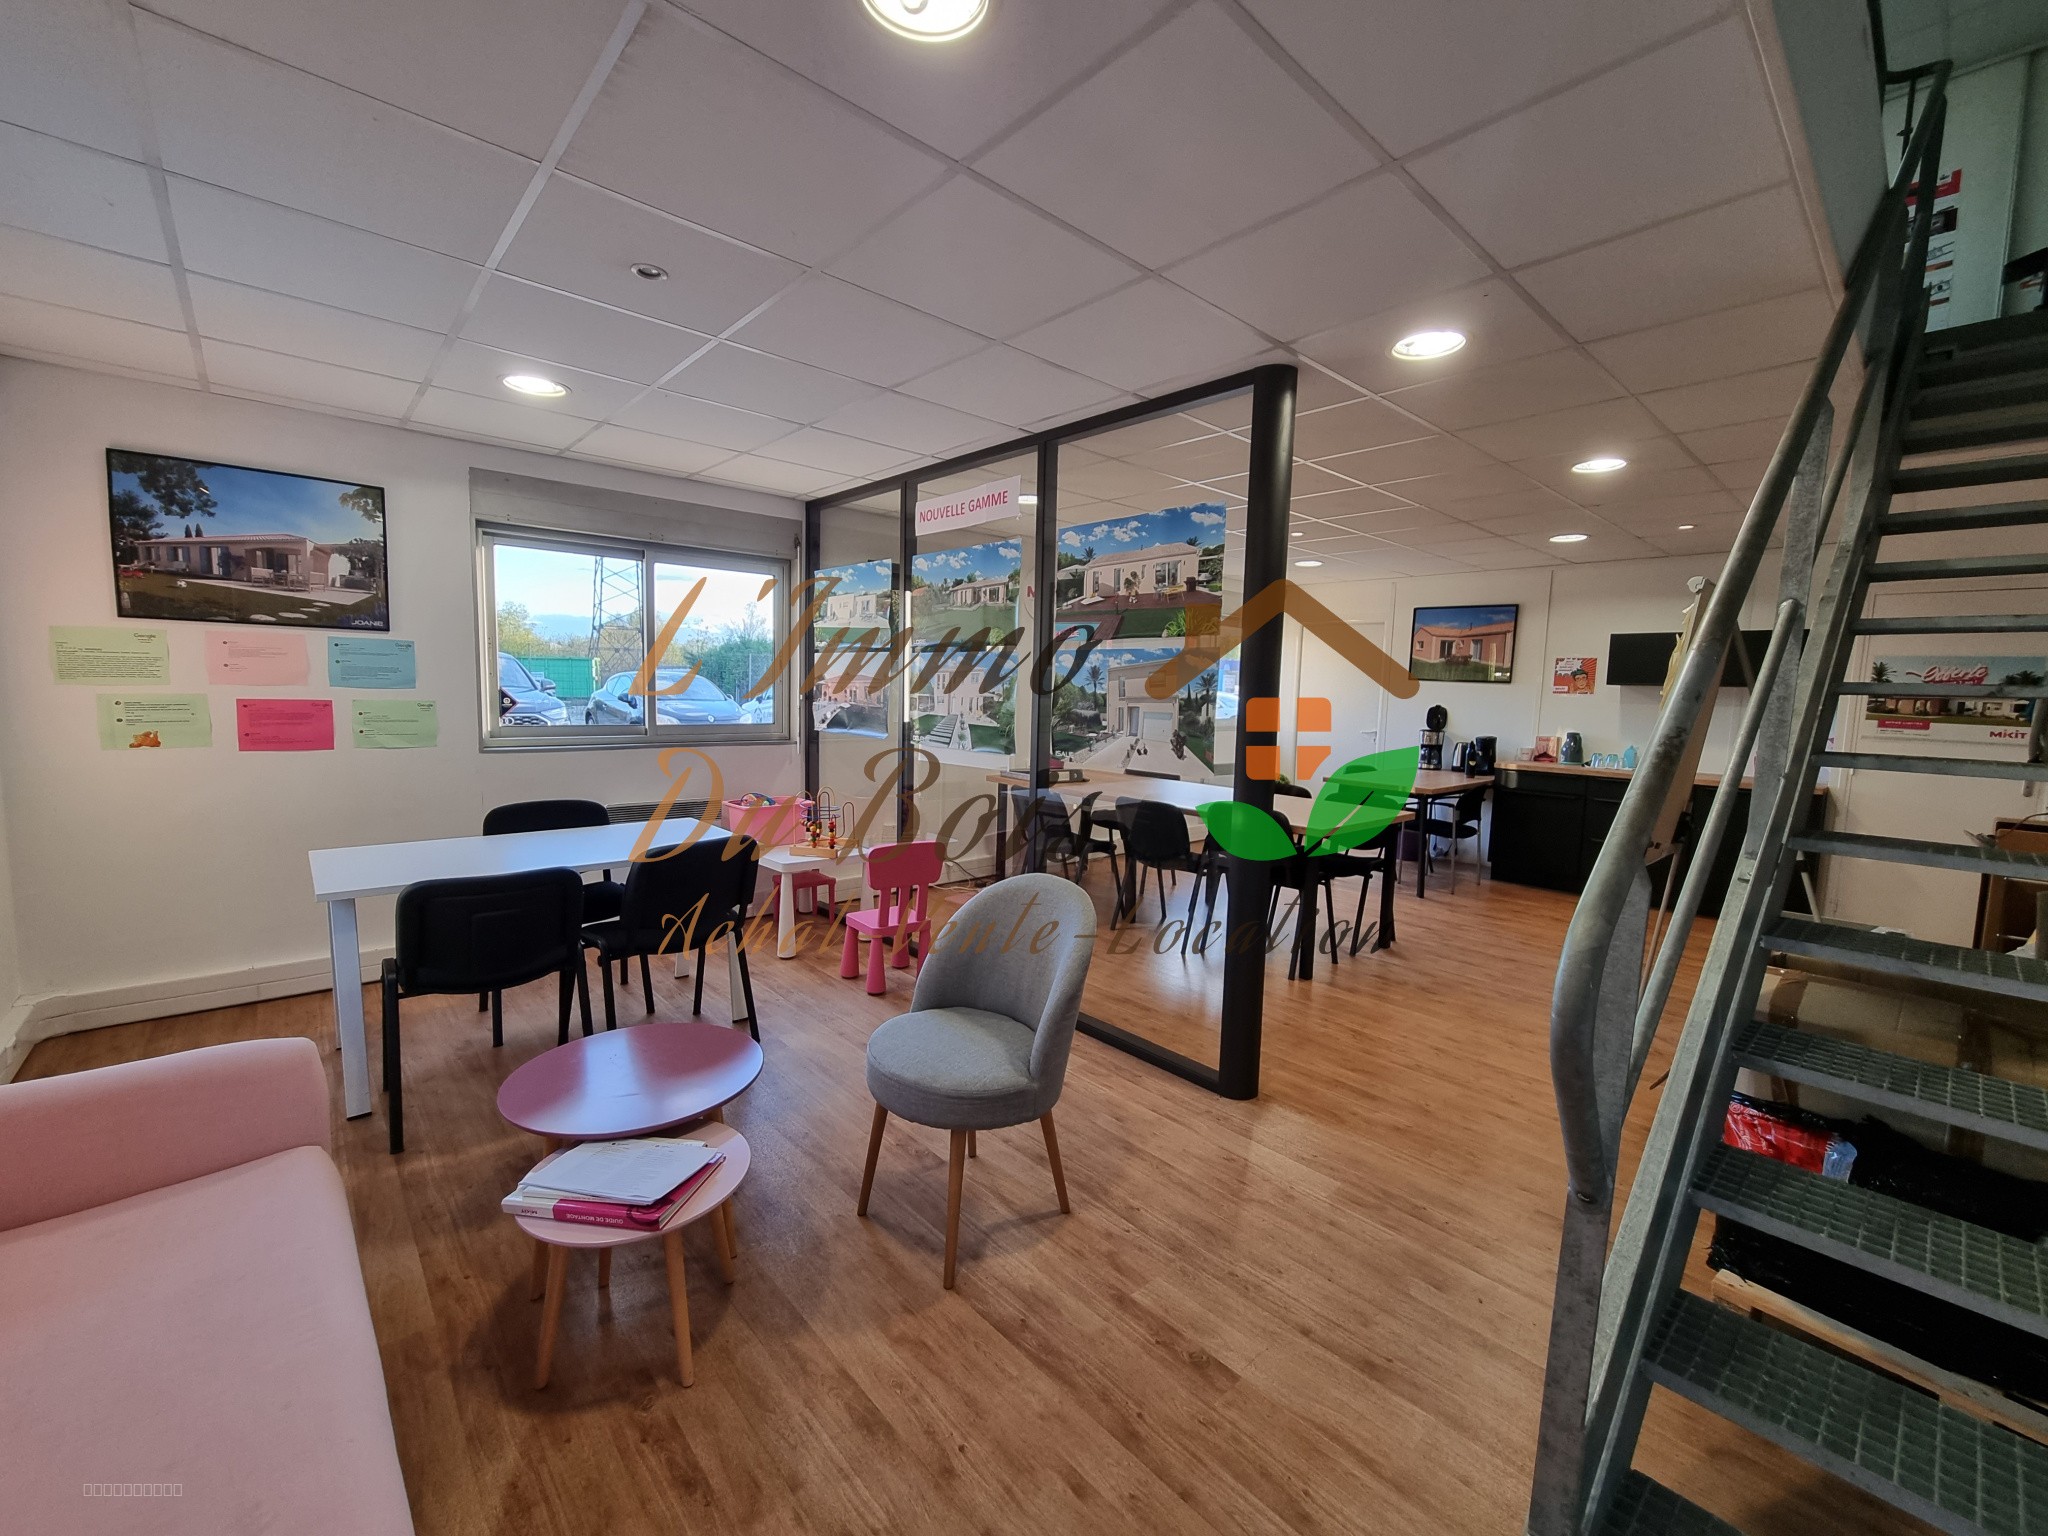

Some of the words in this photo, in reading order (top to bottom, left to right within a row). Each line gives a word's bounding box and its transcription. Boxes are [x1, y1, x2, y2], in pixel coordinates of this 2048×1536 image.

[919, 502, 966, 523] NOUVELLE
[968, 490, 1009, 513] GAMME
[605, 1217, 624, 1225] GUIDE
